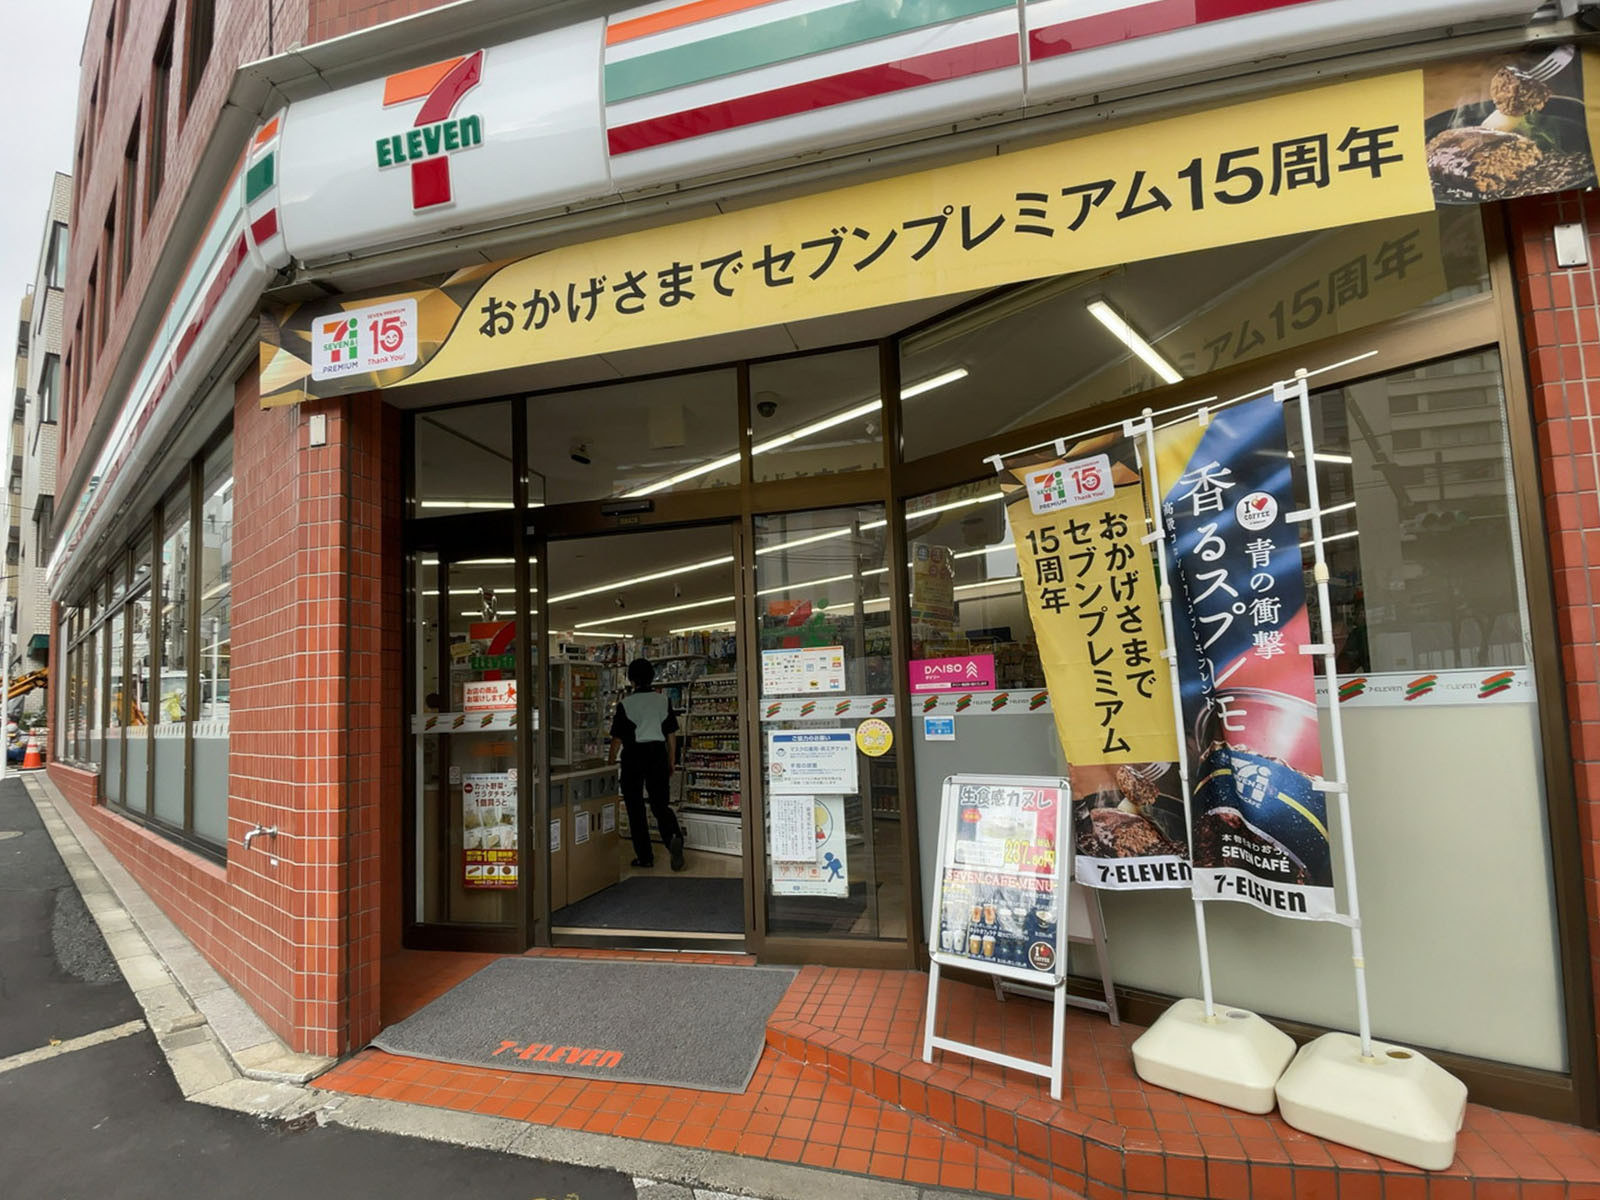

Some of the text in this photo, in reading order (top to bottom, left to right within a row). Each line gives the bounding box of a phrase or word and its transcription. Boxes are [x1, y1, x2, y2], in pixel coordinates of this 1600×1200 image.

[478, 124, 1404, 338] おかげさまでセブンプレミアム15周年
[322, 361, 358, 373] PREMIUM
[1039, 498, 1067, 509] PREMIUM
[1025, 526, 1070, 614] 15周年
[1099, 511, 1157, 699] おかげさまで
[1177, 460, 1248, 733] 香るスプレモ
[1245, 537, 1286, 660] 青の衝撃
[925, 664, 962, 675] DAISO
[1063, 518, 1131, 754] セブンプレミアム
[961, 787, 1051, 808] 生食感カヌレ
